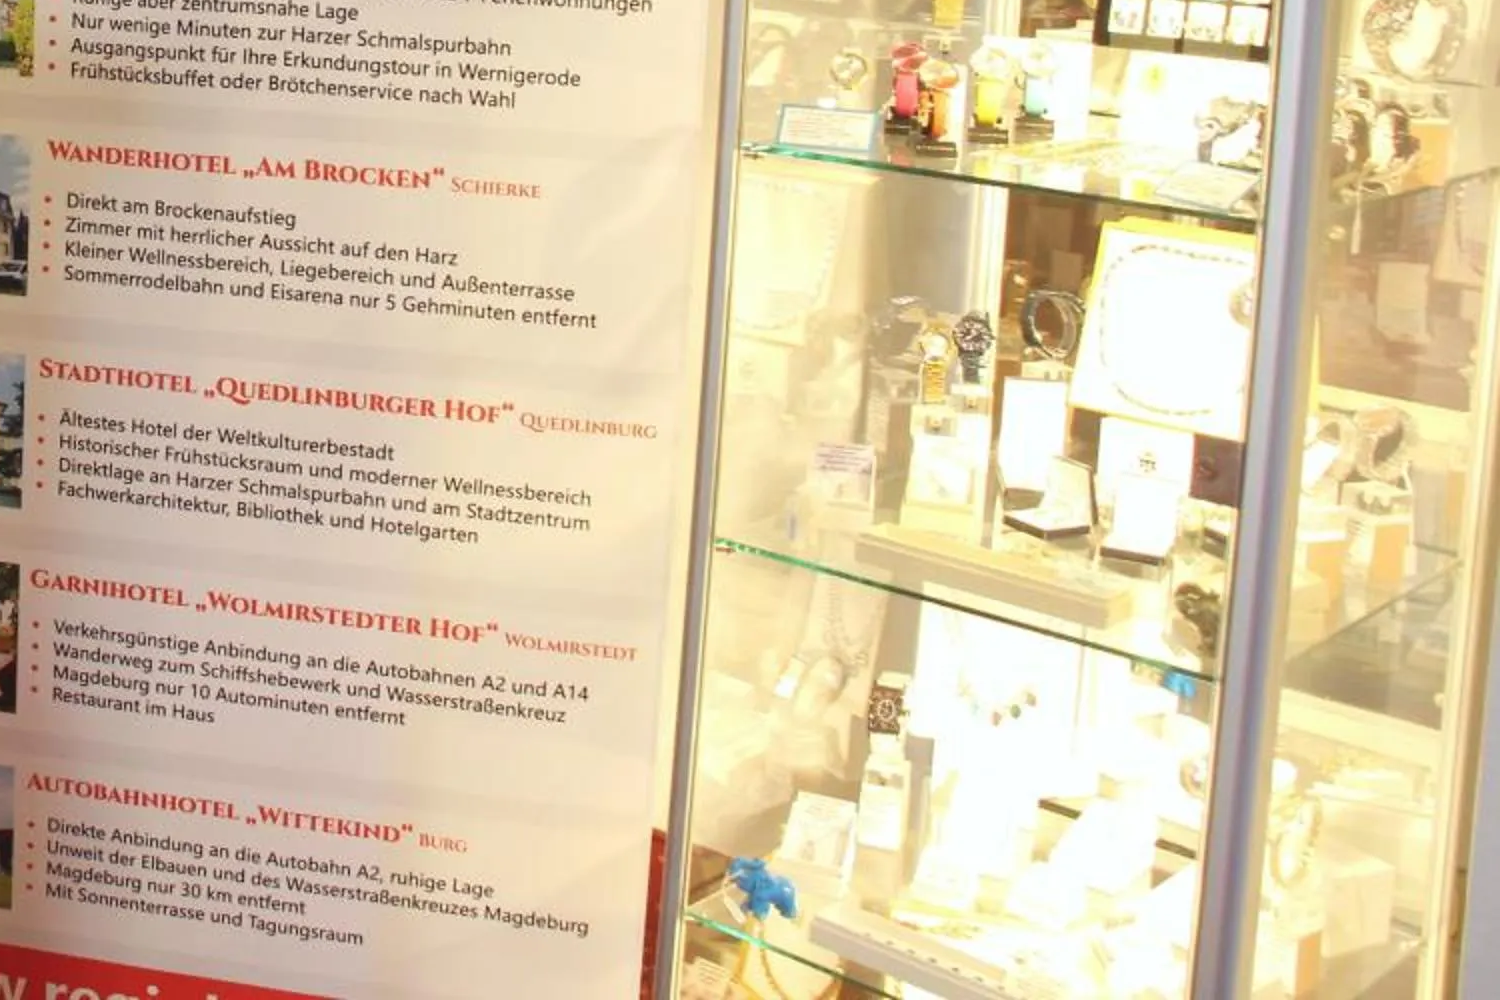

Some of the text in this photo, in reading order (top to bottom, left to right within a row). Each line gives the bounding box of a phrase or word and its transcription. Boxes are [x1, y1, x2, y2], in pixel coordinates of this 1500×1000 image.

[316, 2, 359, 25] Lage
[69, 38, 581, 88] Ausgangspunkt für Ihre Erkundungstour in Wernigerode
[47, 139, 237, 175] WANDERHOTEL
[451, 176, 540, 198] SCHIERKE
[67, 191, 297, 231] Direkt am Brockenaufstieg
[64, 265, 597, 328] Sommerrodelbahn und Eisarena nur 5 Gehminuten entfernt
[39, 357, 198, 394] STADTHOTEL
[519, 412, 657, 439] QUEDLINBURG
[60, 408, 395, 461] Ältestes Hotel der Weltkulturerbestadt
[60, 434, 592, 507] Historischer Frühstücksraum und moderner Wellnessbereich
[58, 480, 479, 544] Fachwerkarchitektur, Bibliothek und Hotelgarten
[29, 568, 190, 607] GARNIHOTEL
[504, 632, 637, 661] WOLMIRSTEDT
[52, 686, 215, 723] Restaurant im Haus
[53, 641, 567, 724] Wanderweg zum Schiffshebewerk und Wasserstraßenkreuz
[53, 664, 406, 726] Magdeburg nur 10 Autominuten entfernt
[27, 773, 240, 820] AUTOBAHNHOTEL
[419, 832, 468, 853] BURG
[46, 861, 307, 916] Magdeburg nur 30 km entfernt
[48, 817, 495, 900] Direkte Anbindung an die Autobahn A2, ruhige Lage
[46, 882, 364, 946] Mit Sonnenterrasse und Tagungsraum
